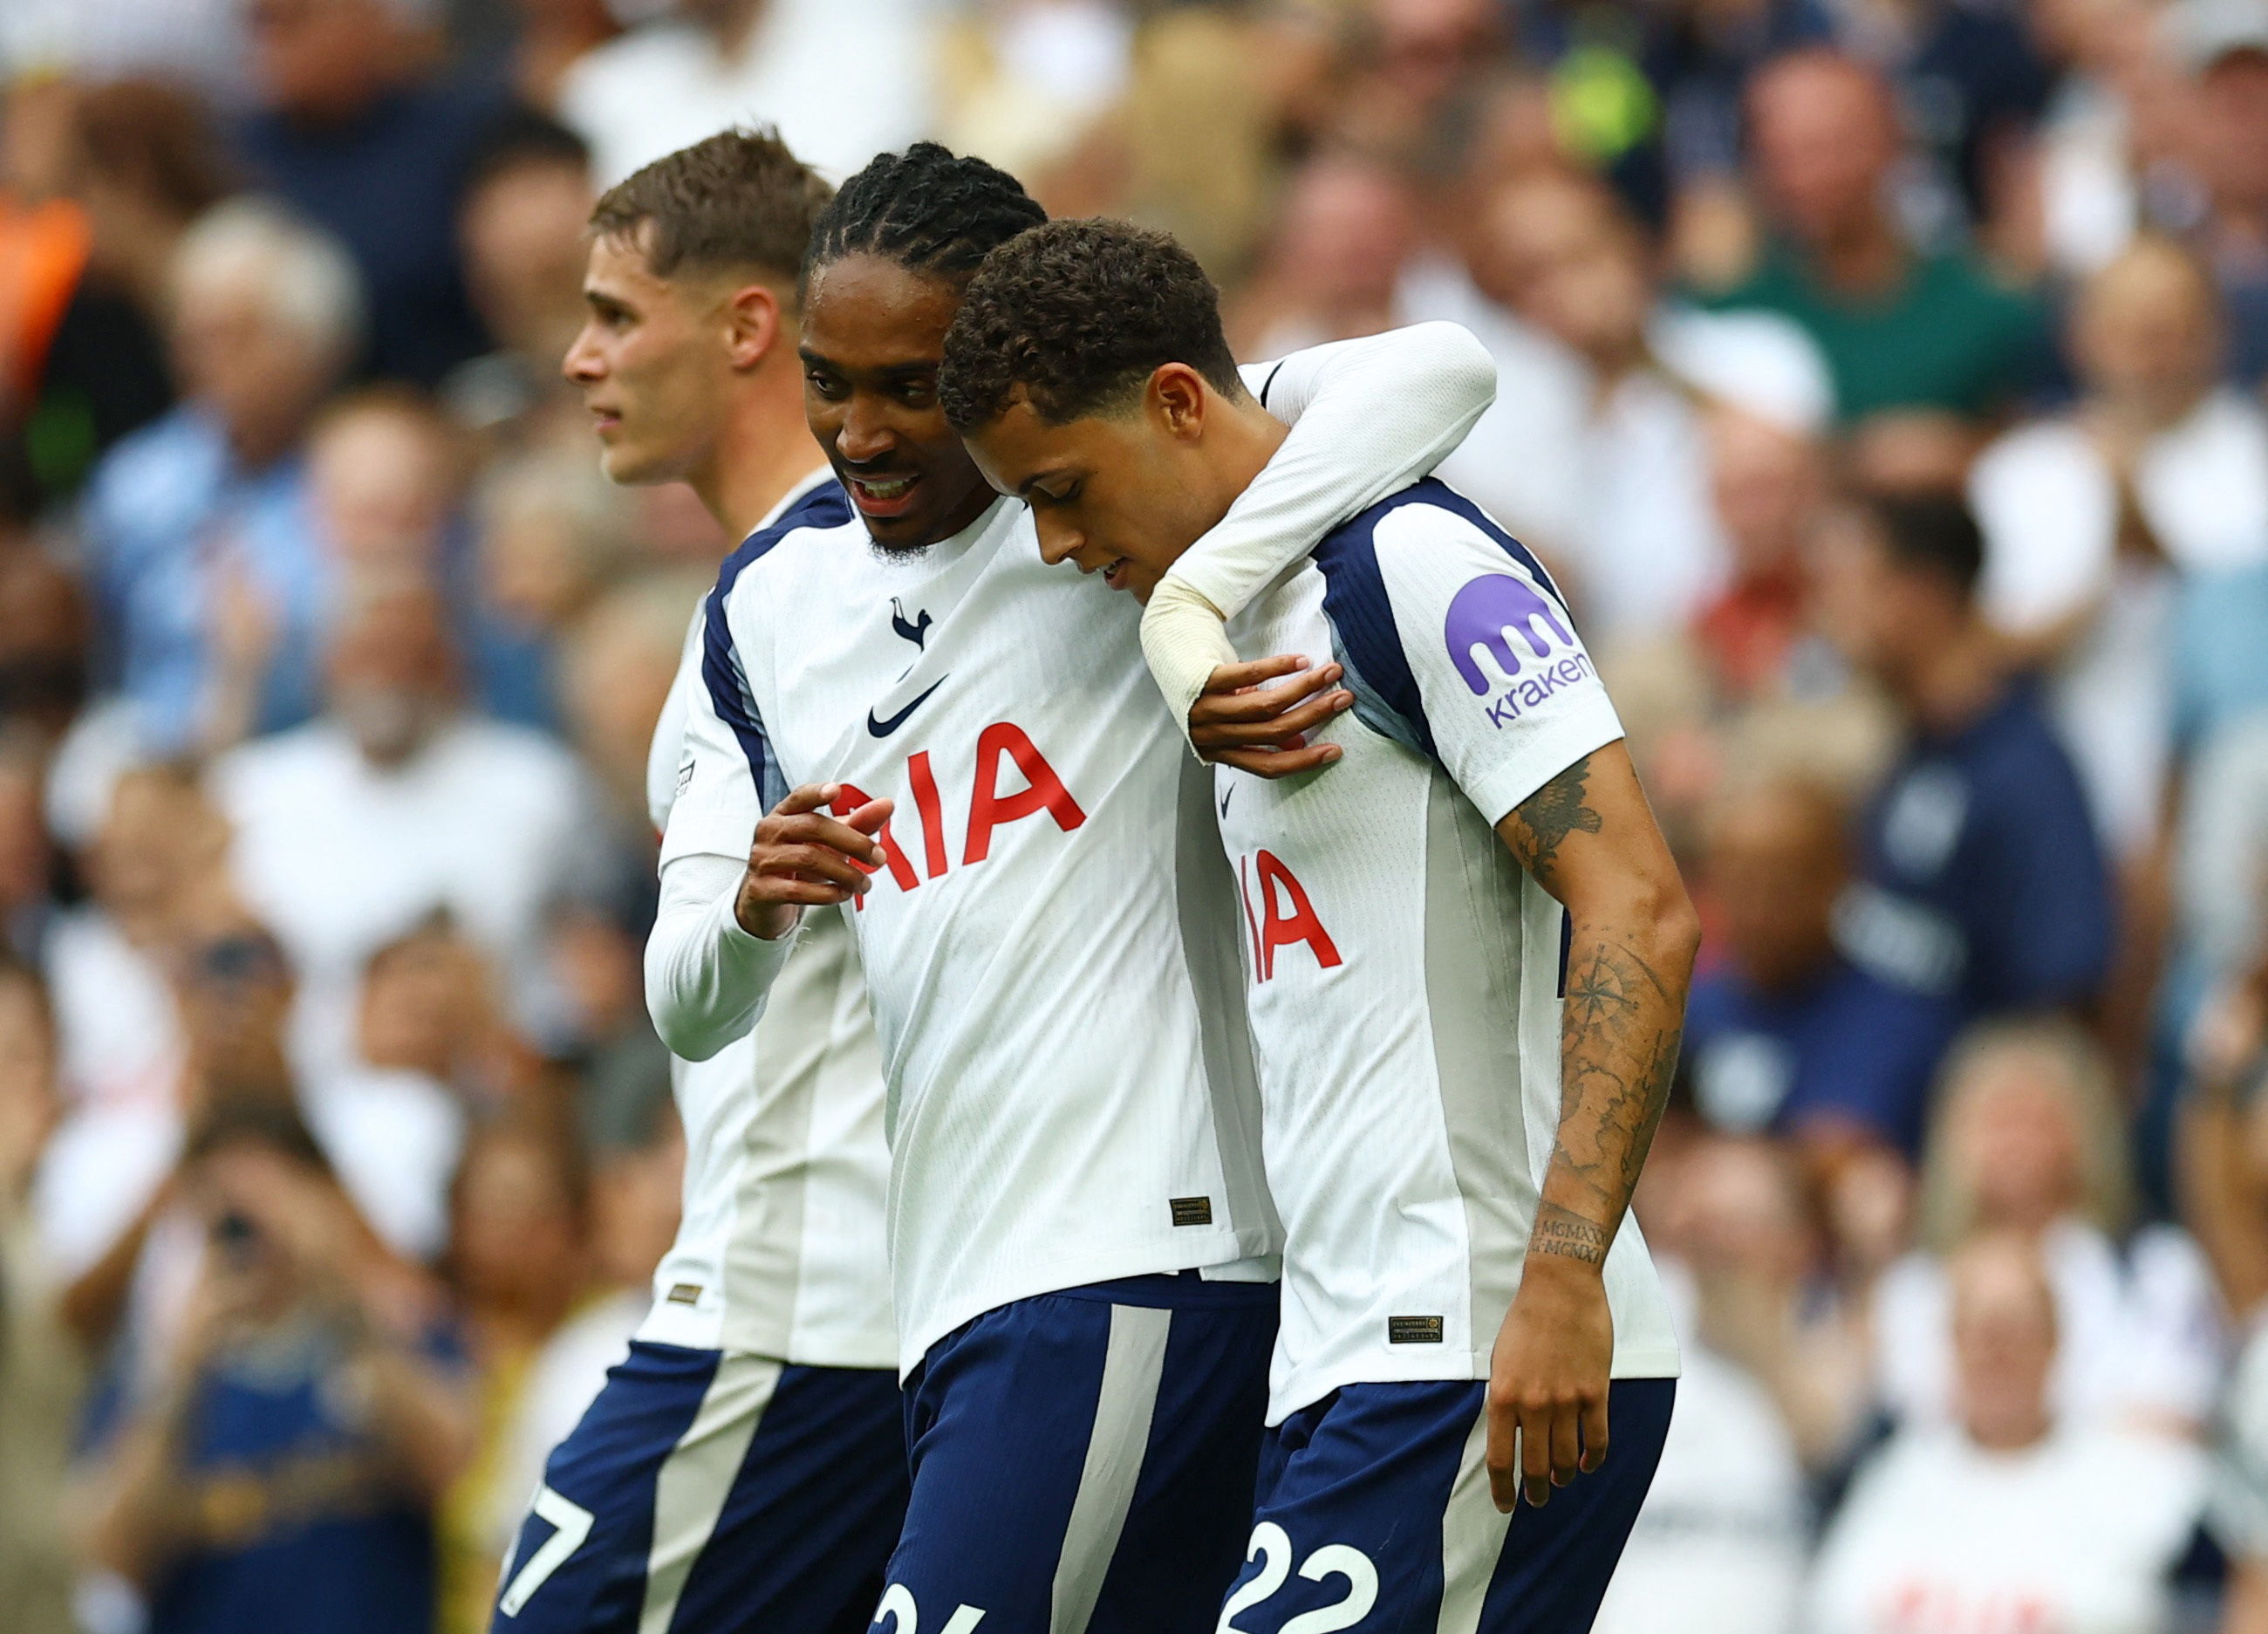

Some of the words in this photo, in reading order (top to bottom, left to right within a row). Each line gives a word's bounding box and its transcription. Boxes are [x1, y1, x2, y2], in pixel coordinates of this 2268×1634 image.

[1485, 653, 1595, 729] kraken
[499, 1484, 597, 1619] 7
[1214, 1521, 1379, 1634] 22
